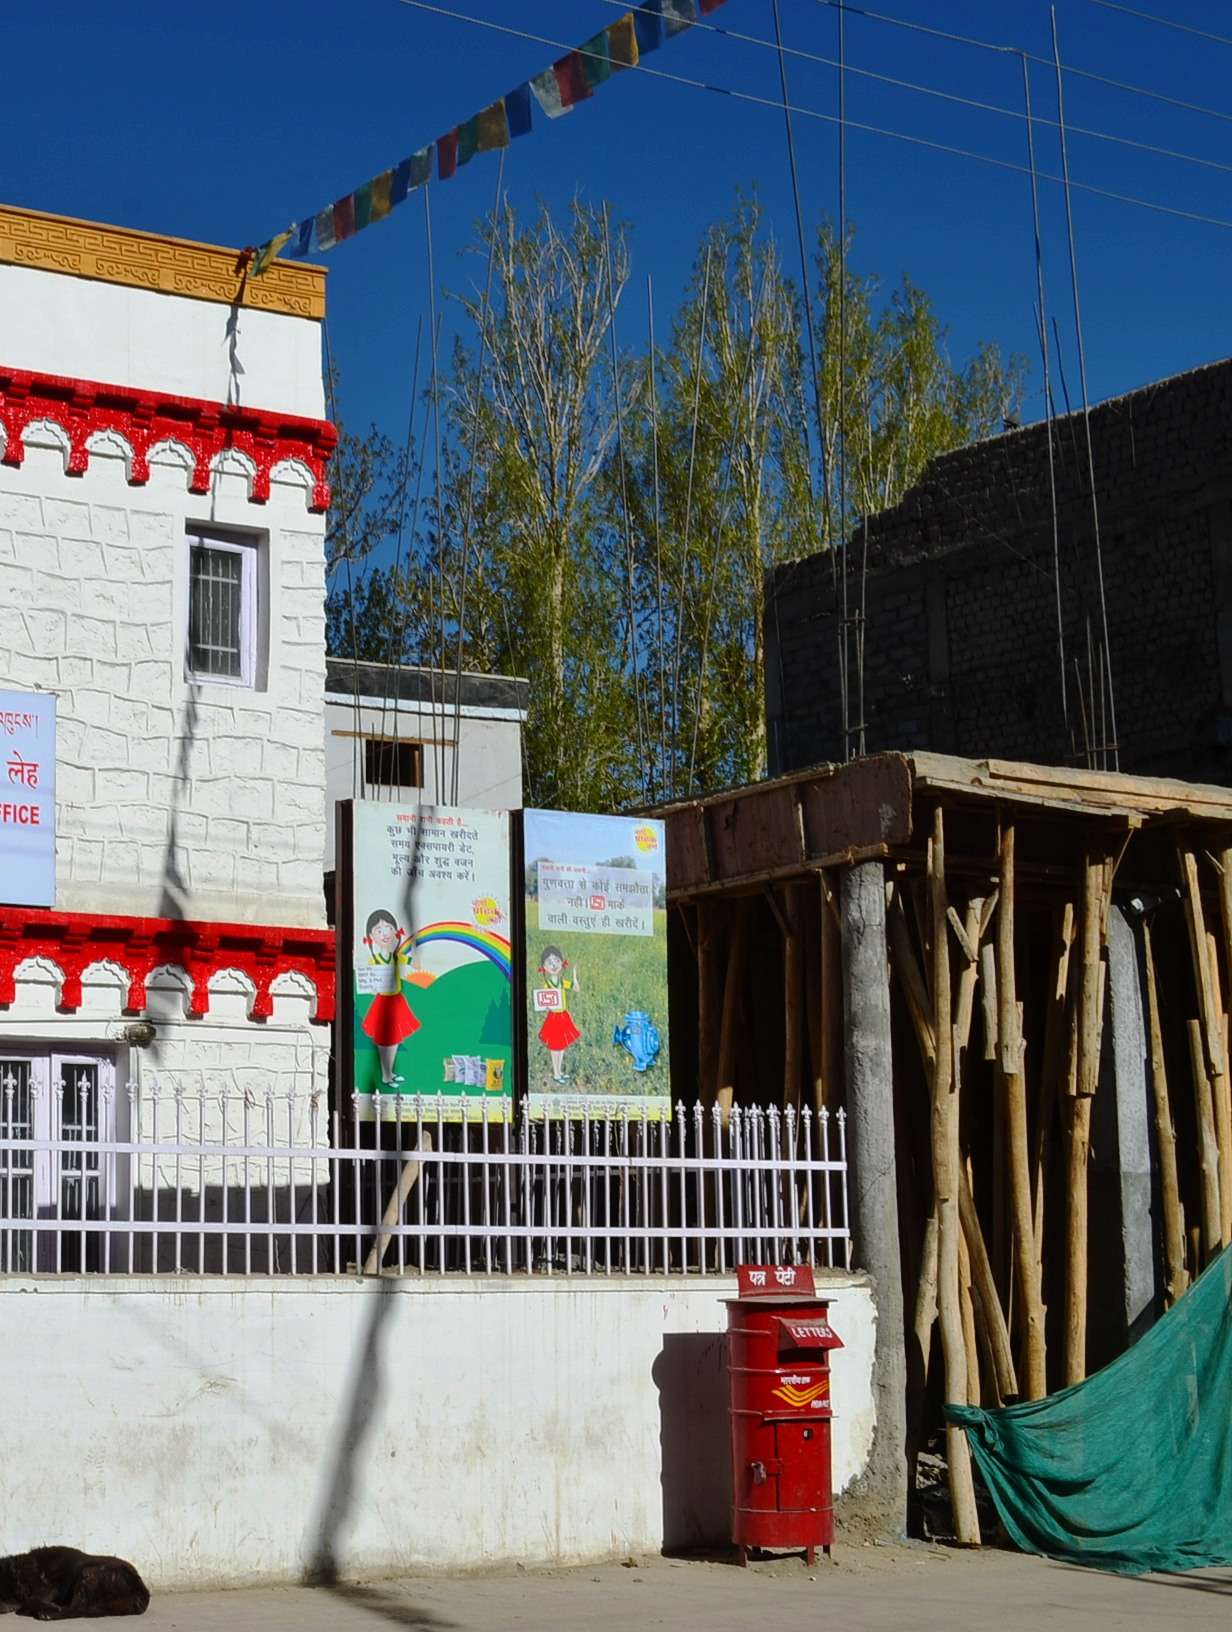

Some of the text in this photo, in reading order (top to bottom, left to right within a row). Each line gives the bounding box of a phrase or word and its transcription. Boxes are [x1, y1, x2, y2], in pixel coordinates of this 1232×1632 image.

[6, 750, 39, 790] लेह
[387, 825, 478, 840] कुछ भी सामान खरीदते
[391, 839, 410, 849] समय
[392, 853, 410, 865] मूल्य
[434, 856, 450, 869] शुद्ध
[454, 858, 474, 868] वजन
[428, 870, 452, 880] अवश्य
[578, 878, 586, 889] से
[591, 878, 609, 893] कोई
[547, 913, 568, 925] वाली
[601, 915, 610, 927] ही
[748, 1266, 797, 1286] पत्र पेटी
[791, 1327, 833, 1338] LETTERS
